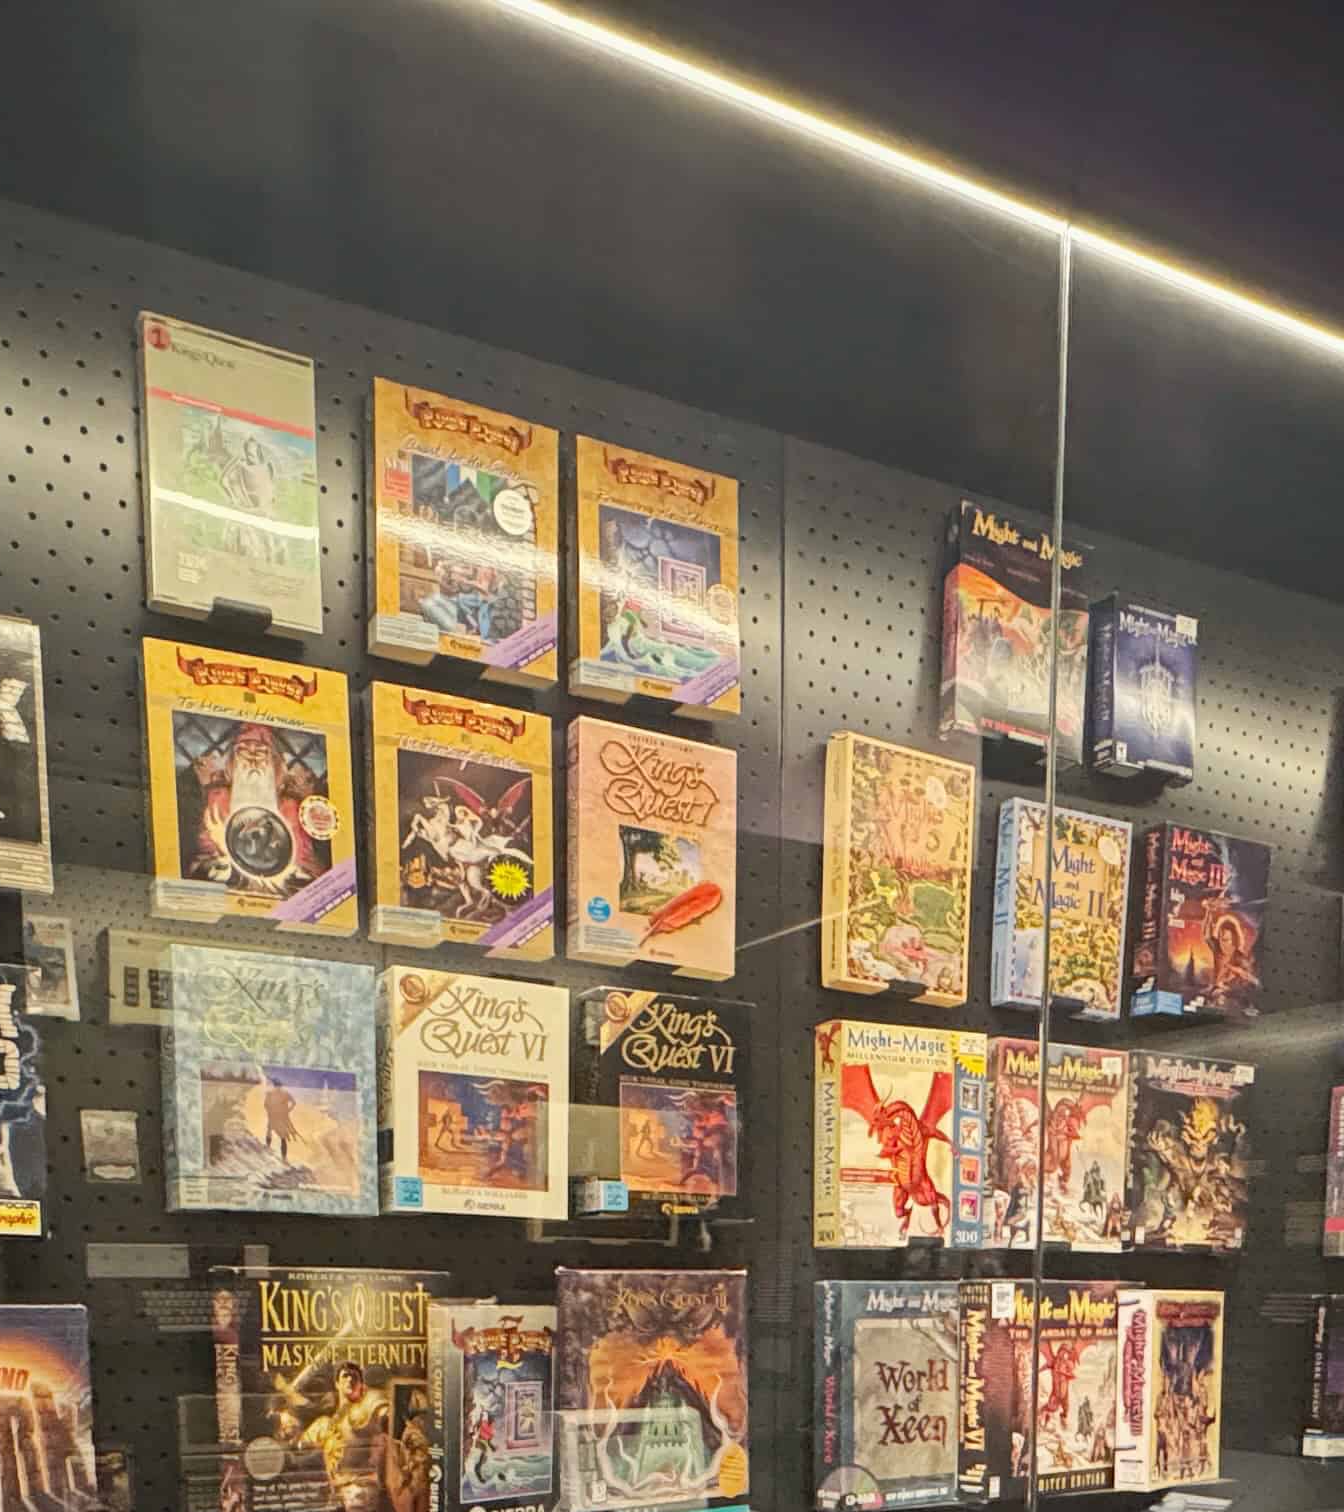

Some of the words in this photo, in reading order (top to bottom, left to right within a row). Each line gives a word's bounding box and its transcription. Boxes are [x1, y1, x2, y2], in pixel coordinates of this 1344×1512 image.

[973, 509, 1020, 545] Might
[1040, 534, 1082, 570] Mgic
[1088, 893, 1108, 918] II
[427, 984, 545, 1031] King's
[630, 1001, 732, 1046] King's
[421, 1019, 518, 1058] Quest
[522, 1034, 550, 1062] VI
[622, 1034, 707, 1072] Quest
[709, 1047, 736, 1074] VI
[847, 1029, 894, 1052] Might
[903, 1035, 947, 1056] Magic
[259, 1280, 344, 1333] KING'S
[345, 1282, 431, 1335] QUEST
[1070, 1290, 1116, 1324] Magic
[967, 1309, 986, 1360] Might
[262, 1343, 318, 1372] MASK
[348, 1343, 429, 1370] ETERNITY
[876, 1360, 950, 1393] World
[908, 1396, 920, 1413] of
[965, 1378, 984, 1427] Magic
[877, 1405, 947, 1448] Xeen
[964, 1428, 984, 1451] VI
